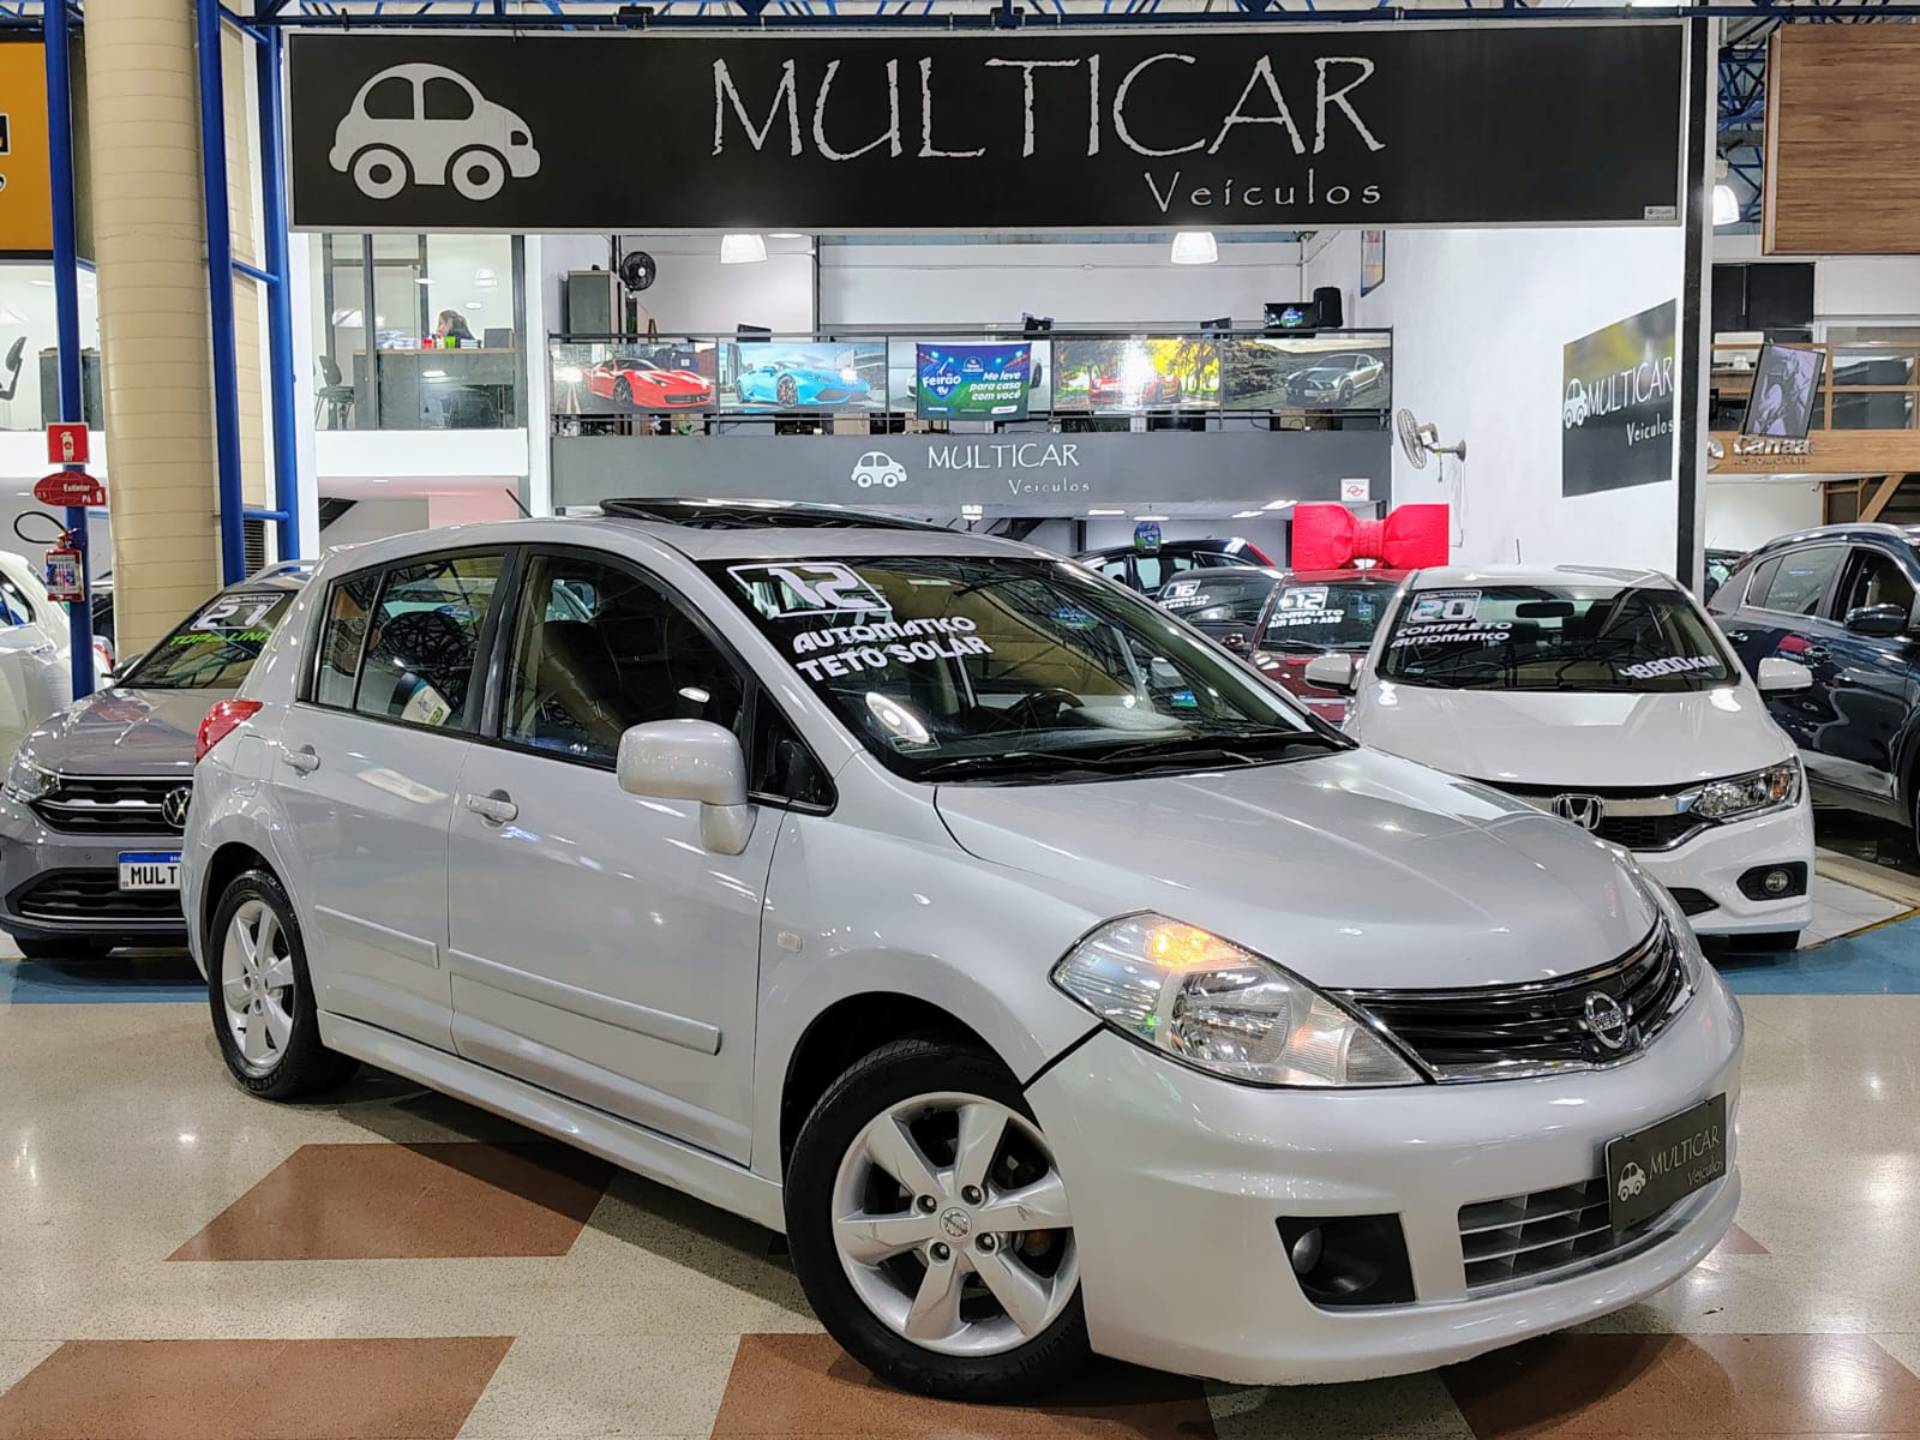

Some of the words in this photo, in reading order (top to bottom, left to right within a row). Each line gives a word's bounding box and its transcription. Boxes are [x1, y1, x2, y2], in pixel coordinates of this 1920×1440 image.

[711, 54, 1385, 161] MULTICAR
[1144, 168, 1382, 213] Veículos
[970, 383, 996, 392] para
[997, 381, 1021, 390] casa
[983, 372, 998, 381] Me
[1001, 371, 1021, 380] leve
[1587, 356, 1674, 418] MULTICAR
[972, 391, 995, 400] com
[997, 389, 1021, 400] você
[928, 443, 1080, 470] MULTICAR
[768, 565, 878, 609] 12
[193, 604, 268, 628] 21
[1271, 609, 1344, 621] COMPLETO
[1411, 600, 1475, 620] 20
[1396, 622, 1513, 637] COMPLETO
[796, 649, 889, 682] TETO
[891, 636, 993, 664] SOLAR
[131, 866, 178, 885] MULT
[1650, 1125, 1720, 1181] MULTICAR
